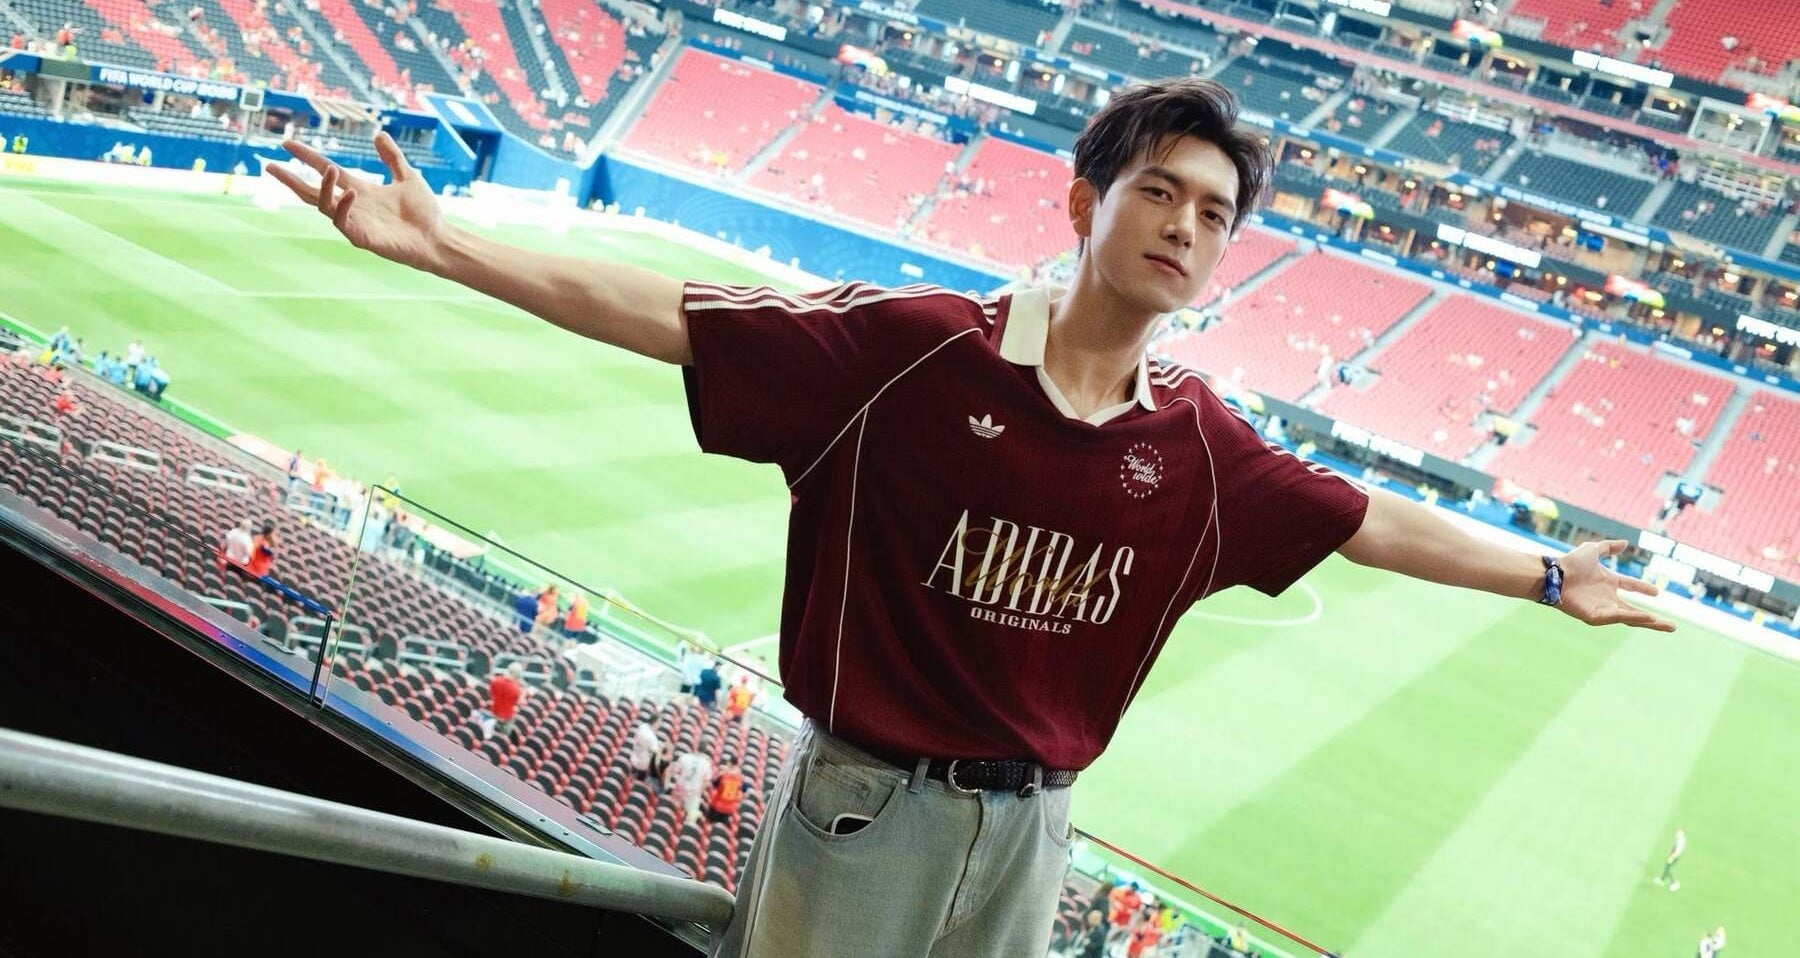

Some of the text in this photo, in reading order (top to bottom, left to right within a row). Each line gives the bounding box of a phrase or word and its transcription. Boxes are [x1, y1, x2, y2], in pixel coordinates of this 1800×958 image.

[1127, 454, 1156, 474] World
[920, 508, 1135, 625] ADIDAS
[961, 527, 1110, 607] World
[970, 606, 1072, 635] ORIGINALS
